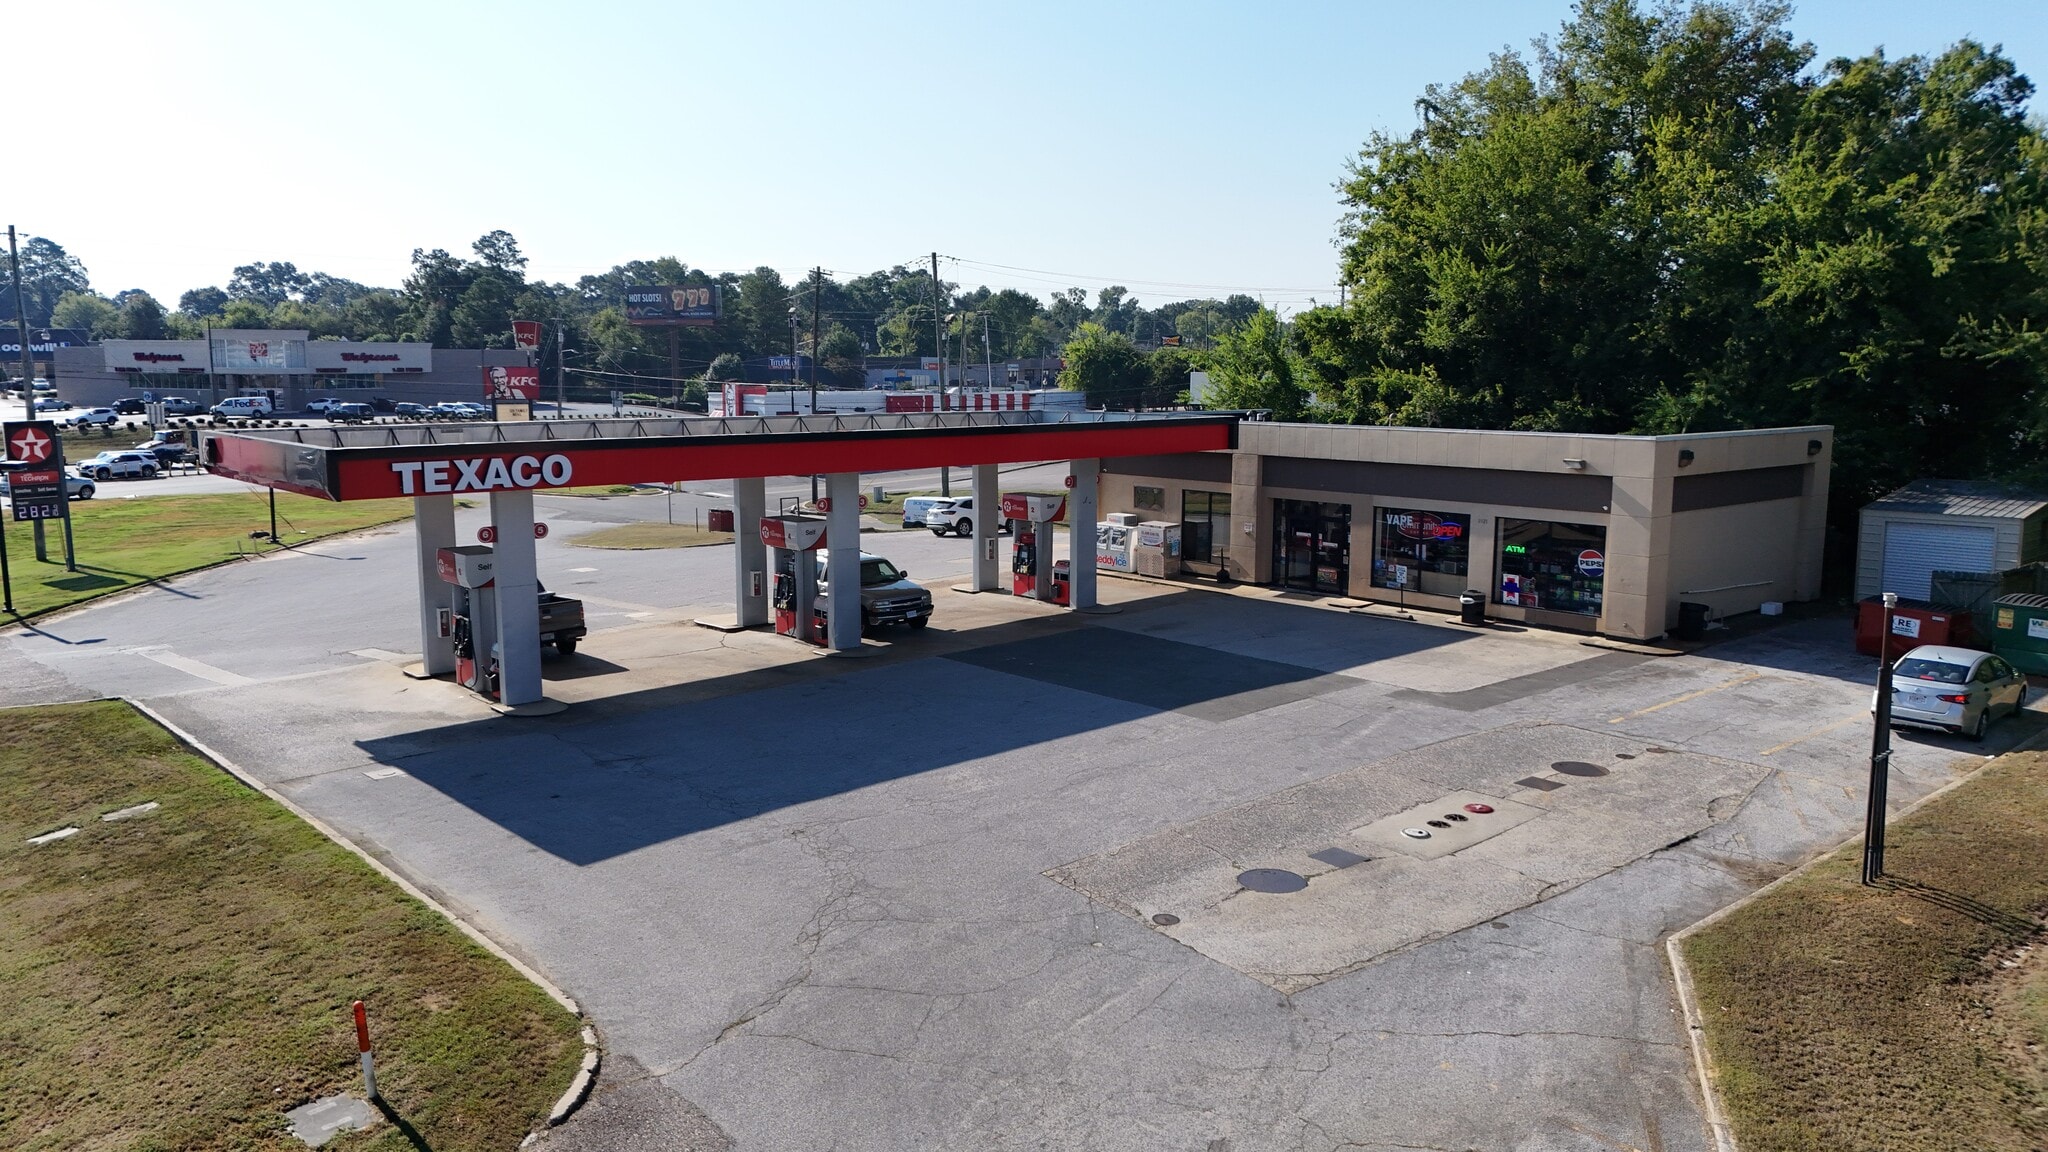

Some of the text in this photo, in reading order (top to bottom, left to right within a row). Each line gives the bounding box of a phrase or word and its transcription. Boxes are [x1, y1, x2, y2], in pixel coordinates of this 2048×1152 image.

[628, 293, 662, 303] HOT SLOTS!
[510, 376, 537, 386] KFC
[234, 399, 263, 407] FedEx
[391, 454, 573, 494] TEXACO
[1386, 514, 1414, 526] VAPE
[482, 531, 489, 539] 6
[537, 526, 543, 534] 5
[1432, 526, 1463, 537] OPEN
[1505, 545, 1526, 554] ATM
[477, 563, 493, 571] Self
[1897, 618, 1912, 628] RE
